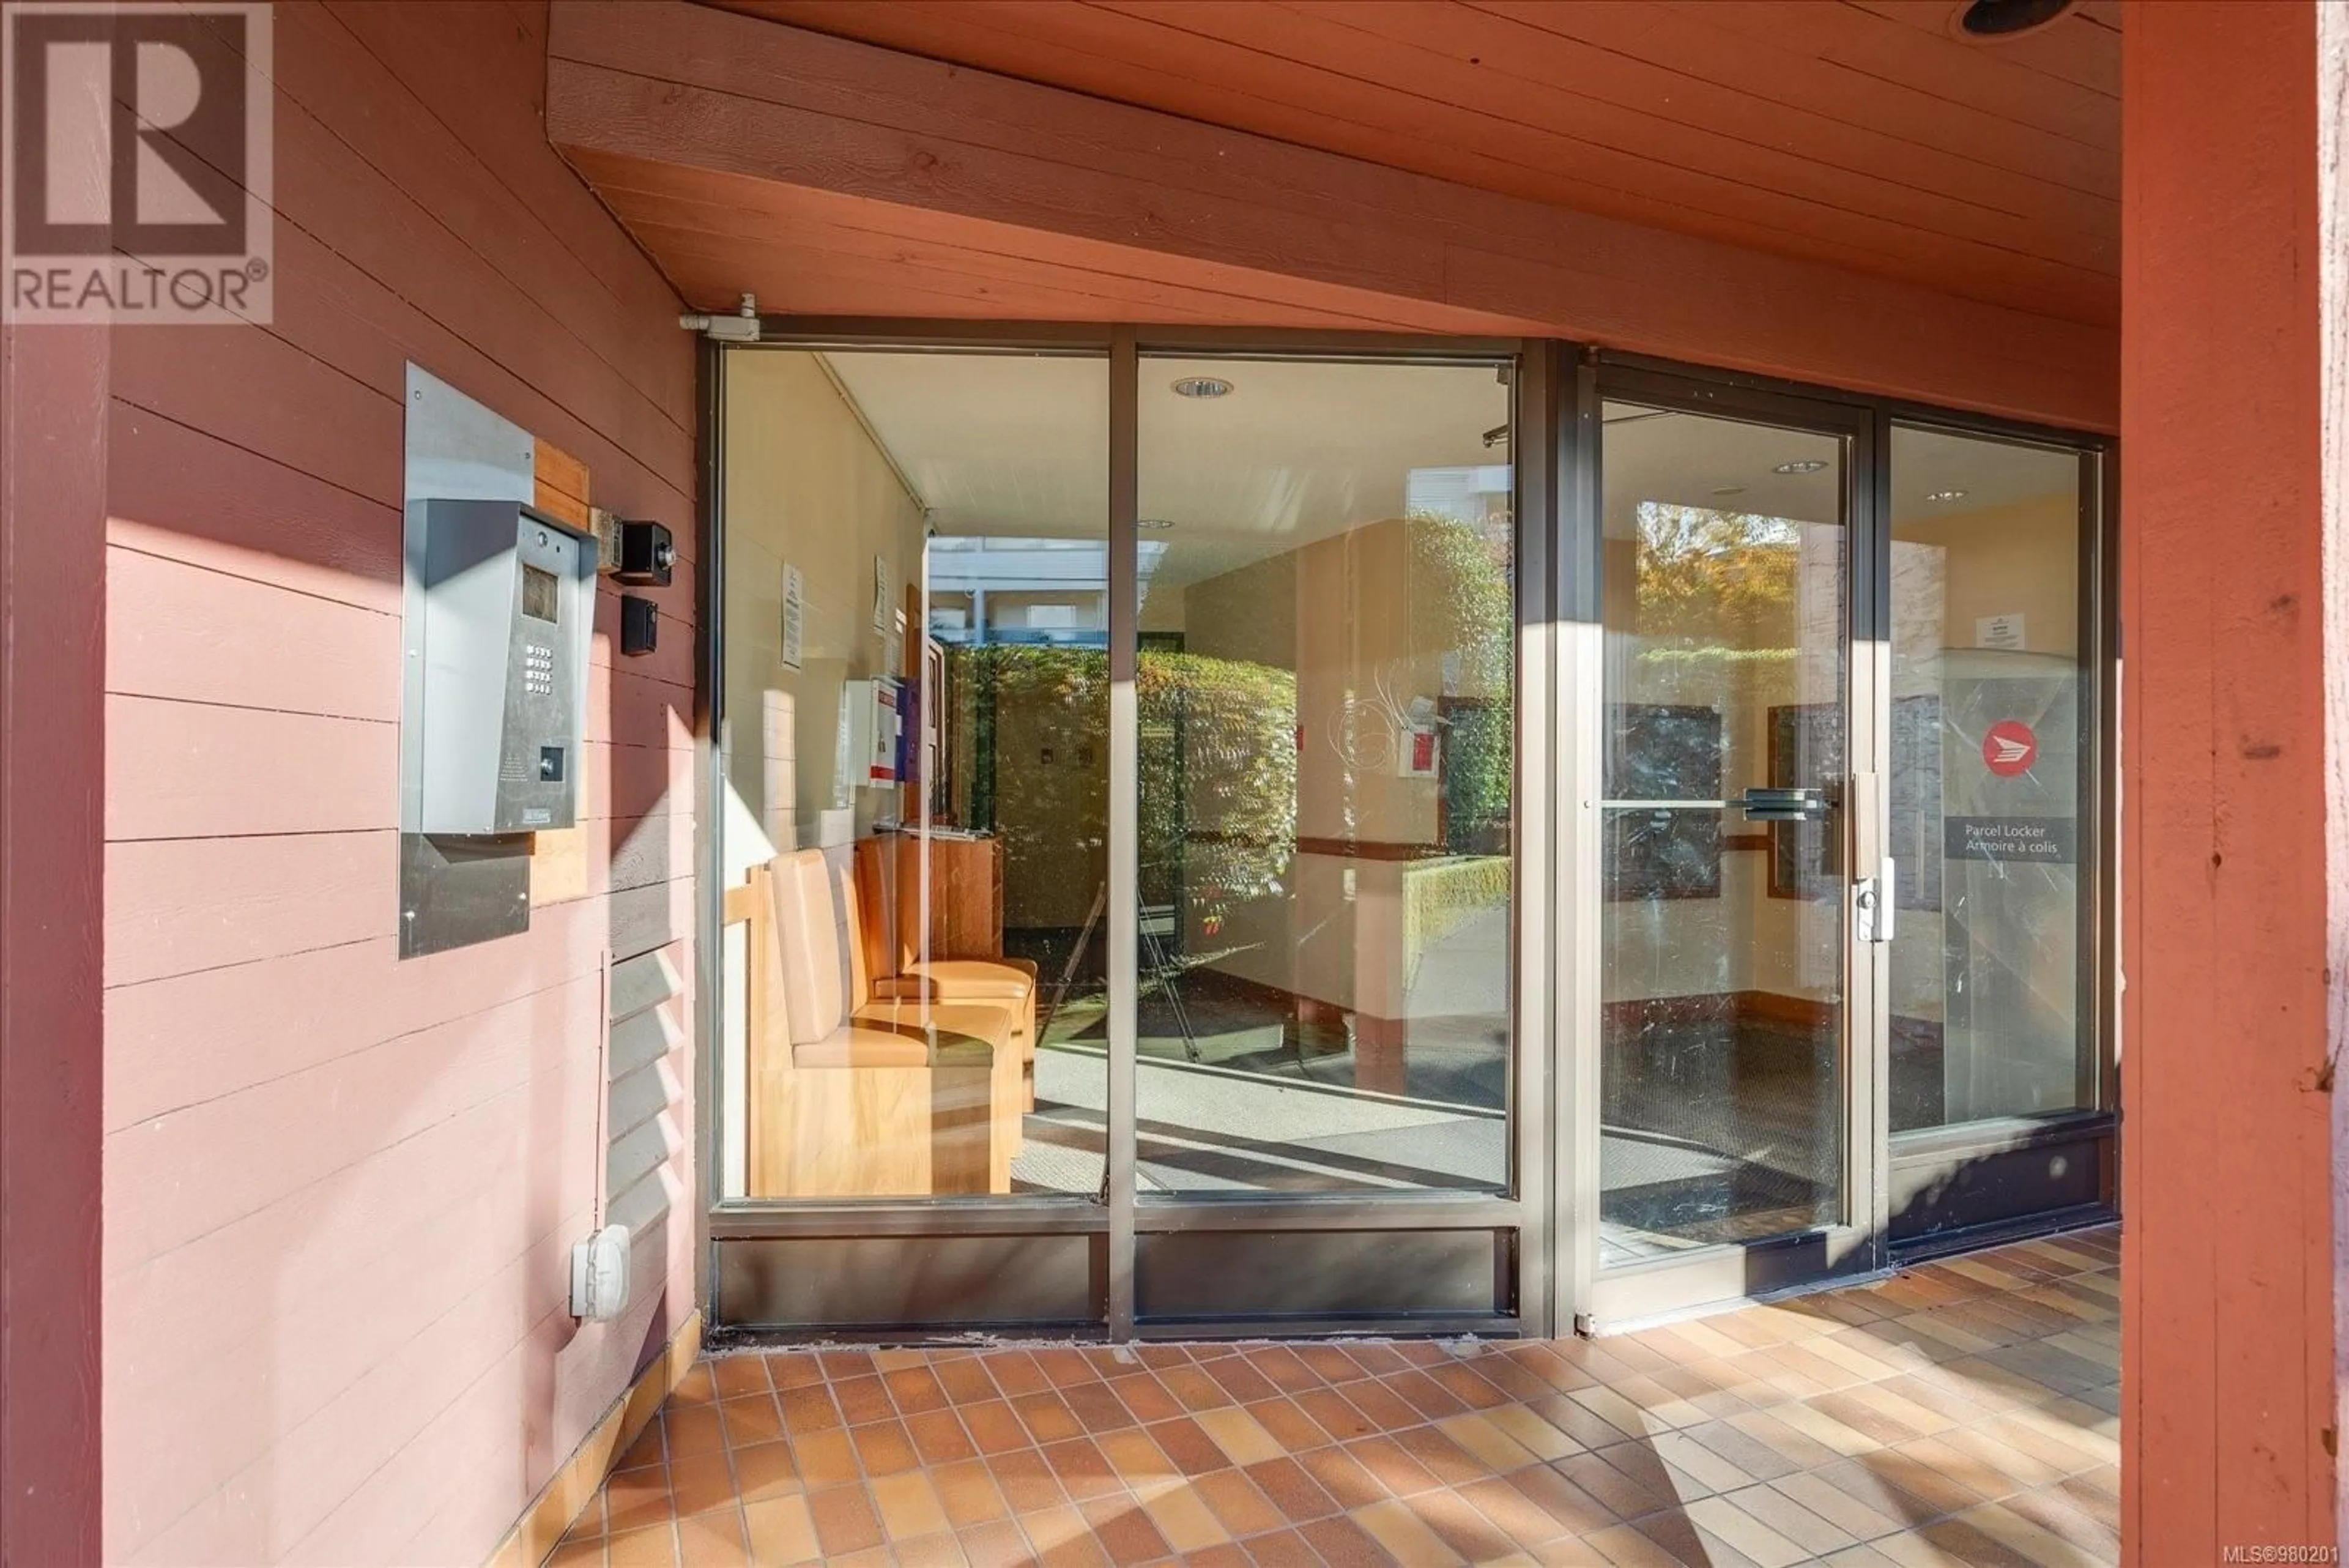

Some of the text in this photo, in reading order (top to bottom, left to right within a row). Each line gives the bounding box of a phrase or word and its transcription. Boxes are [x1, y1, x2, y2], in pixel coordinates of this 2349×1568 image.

[1965, 825, 2045, 837] Parcel Locker
[1965, 839, 2058, 853] Armoire à colis
